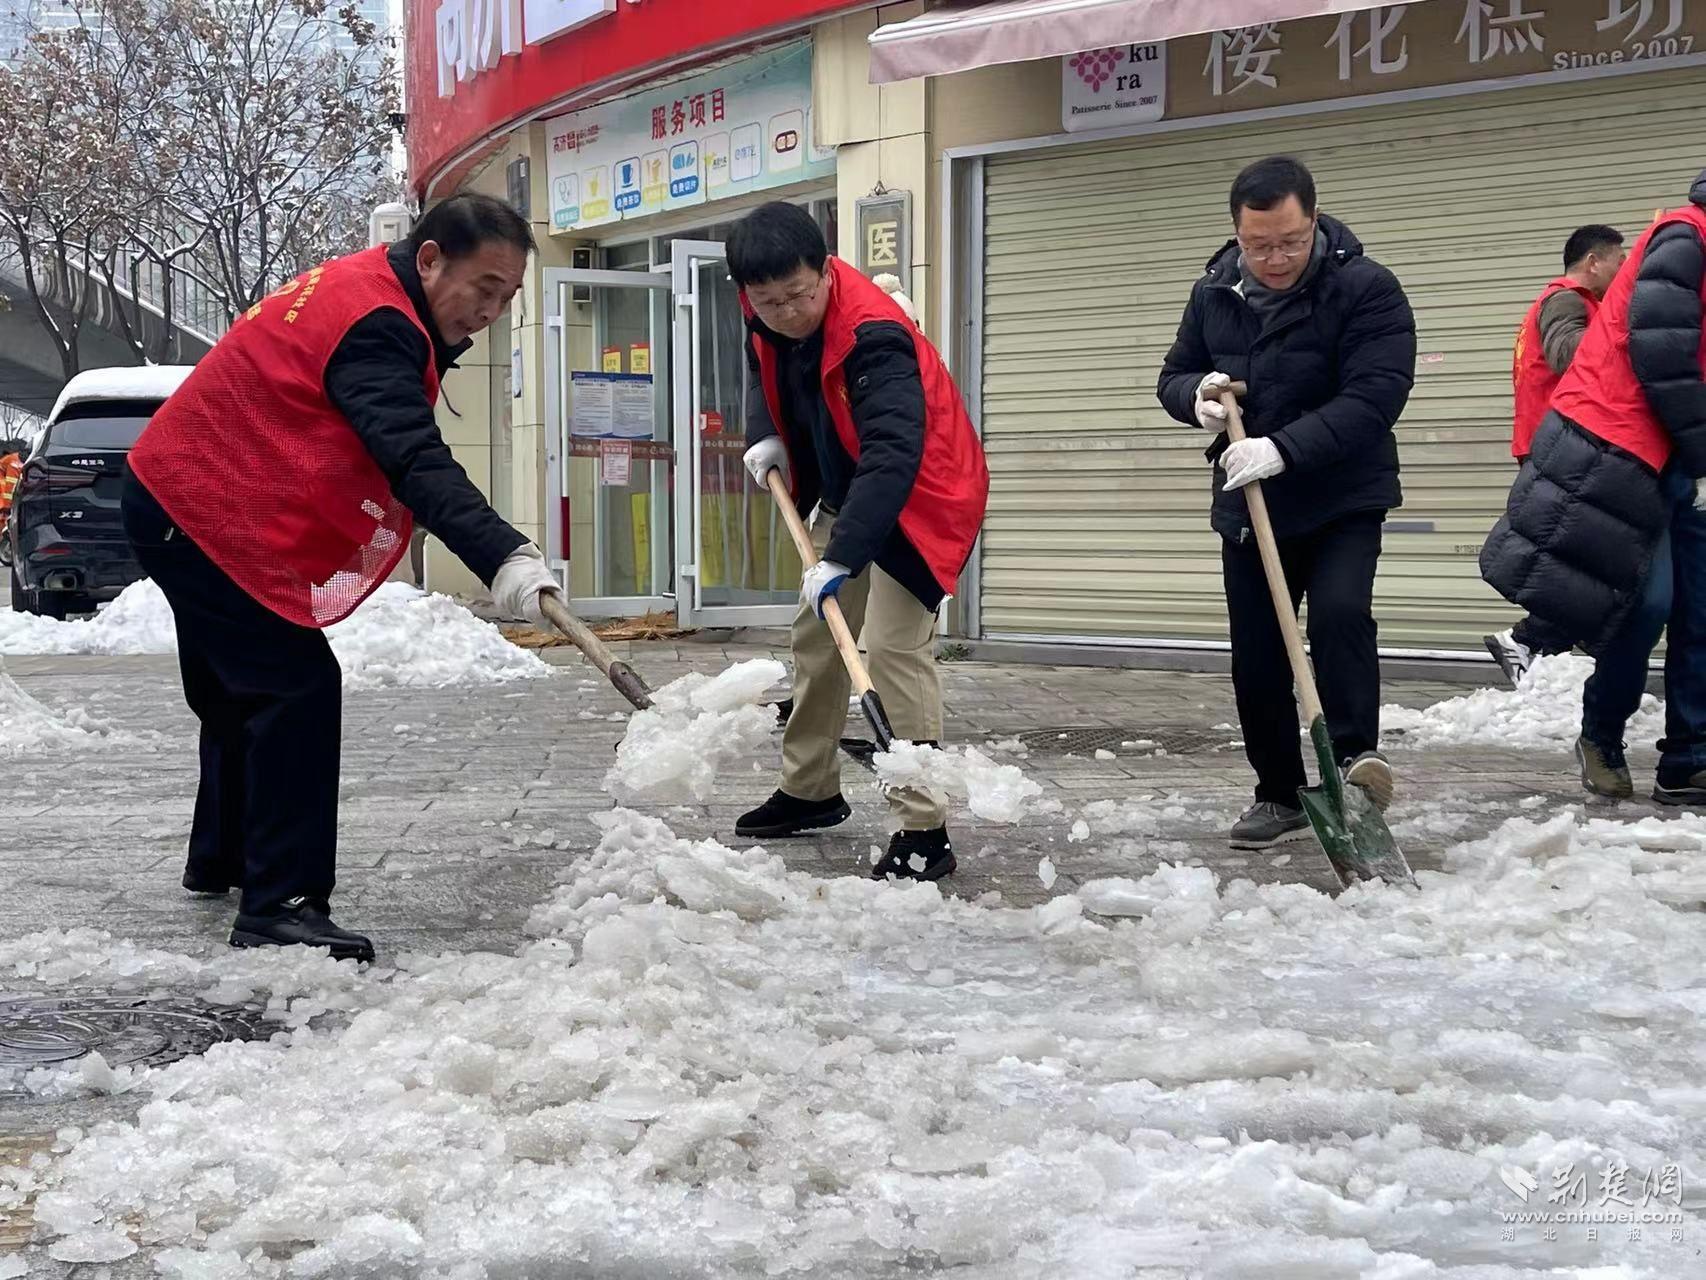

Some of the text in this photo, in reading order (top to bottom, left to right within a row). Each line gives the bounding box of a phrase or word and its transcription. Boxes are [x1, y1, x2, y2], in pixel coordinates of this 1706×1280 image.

[1129, 43, 1158, 63] ku
[1554, 36, 1694, 70] Since 2007
[1116, 72, 1142, 91] ra
[651, 88, 725, 140] 服务项目
[1072, 96, 1158, 115] Patisserie Since 2007
[867, 220, 898, 267] 医
[59, 510, 83, 519] X3
